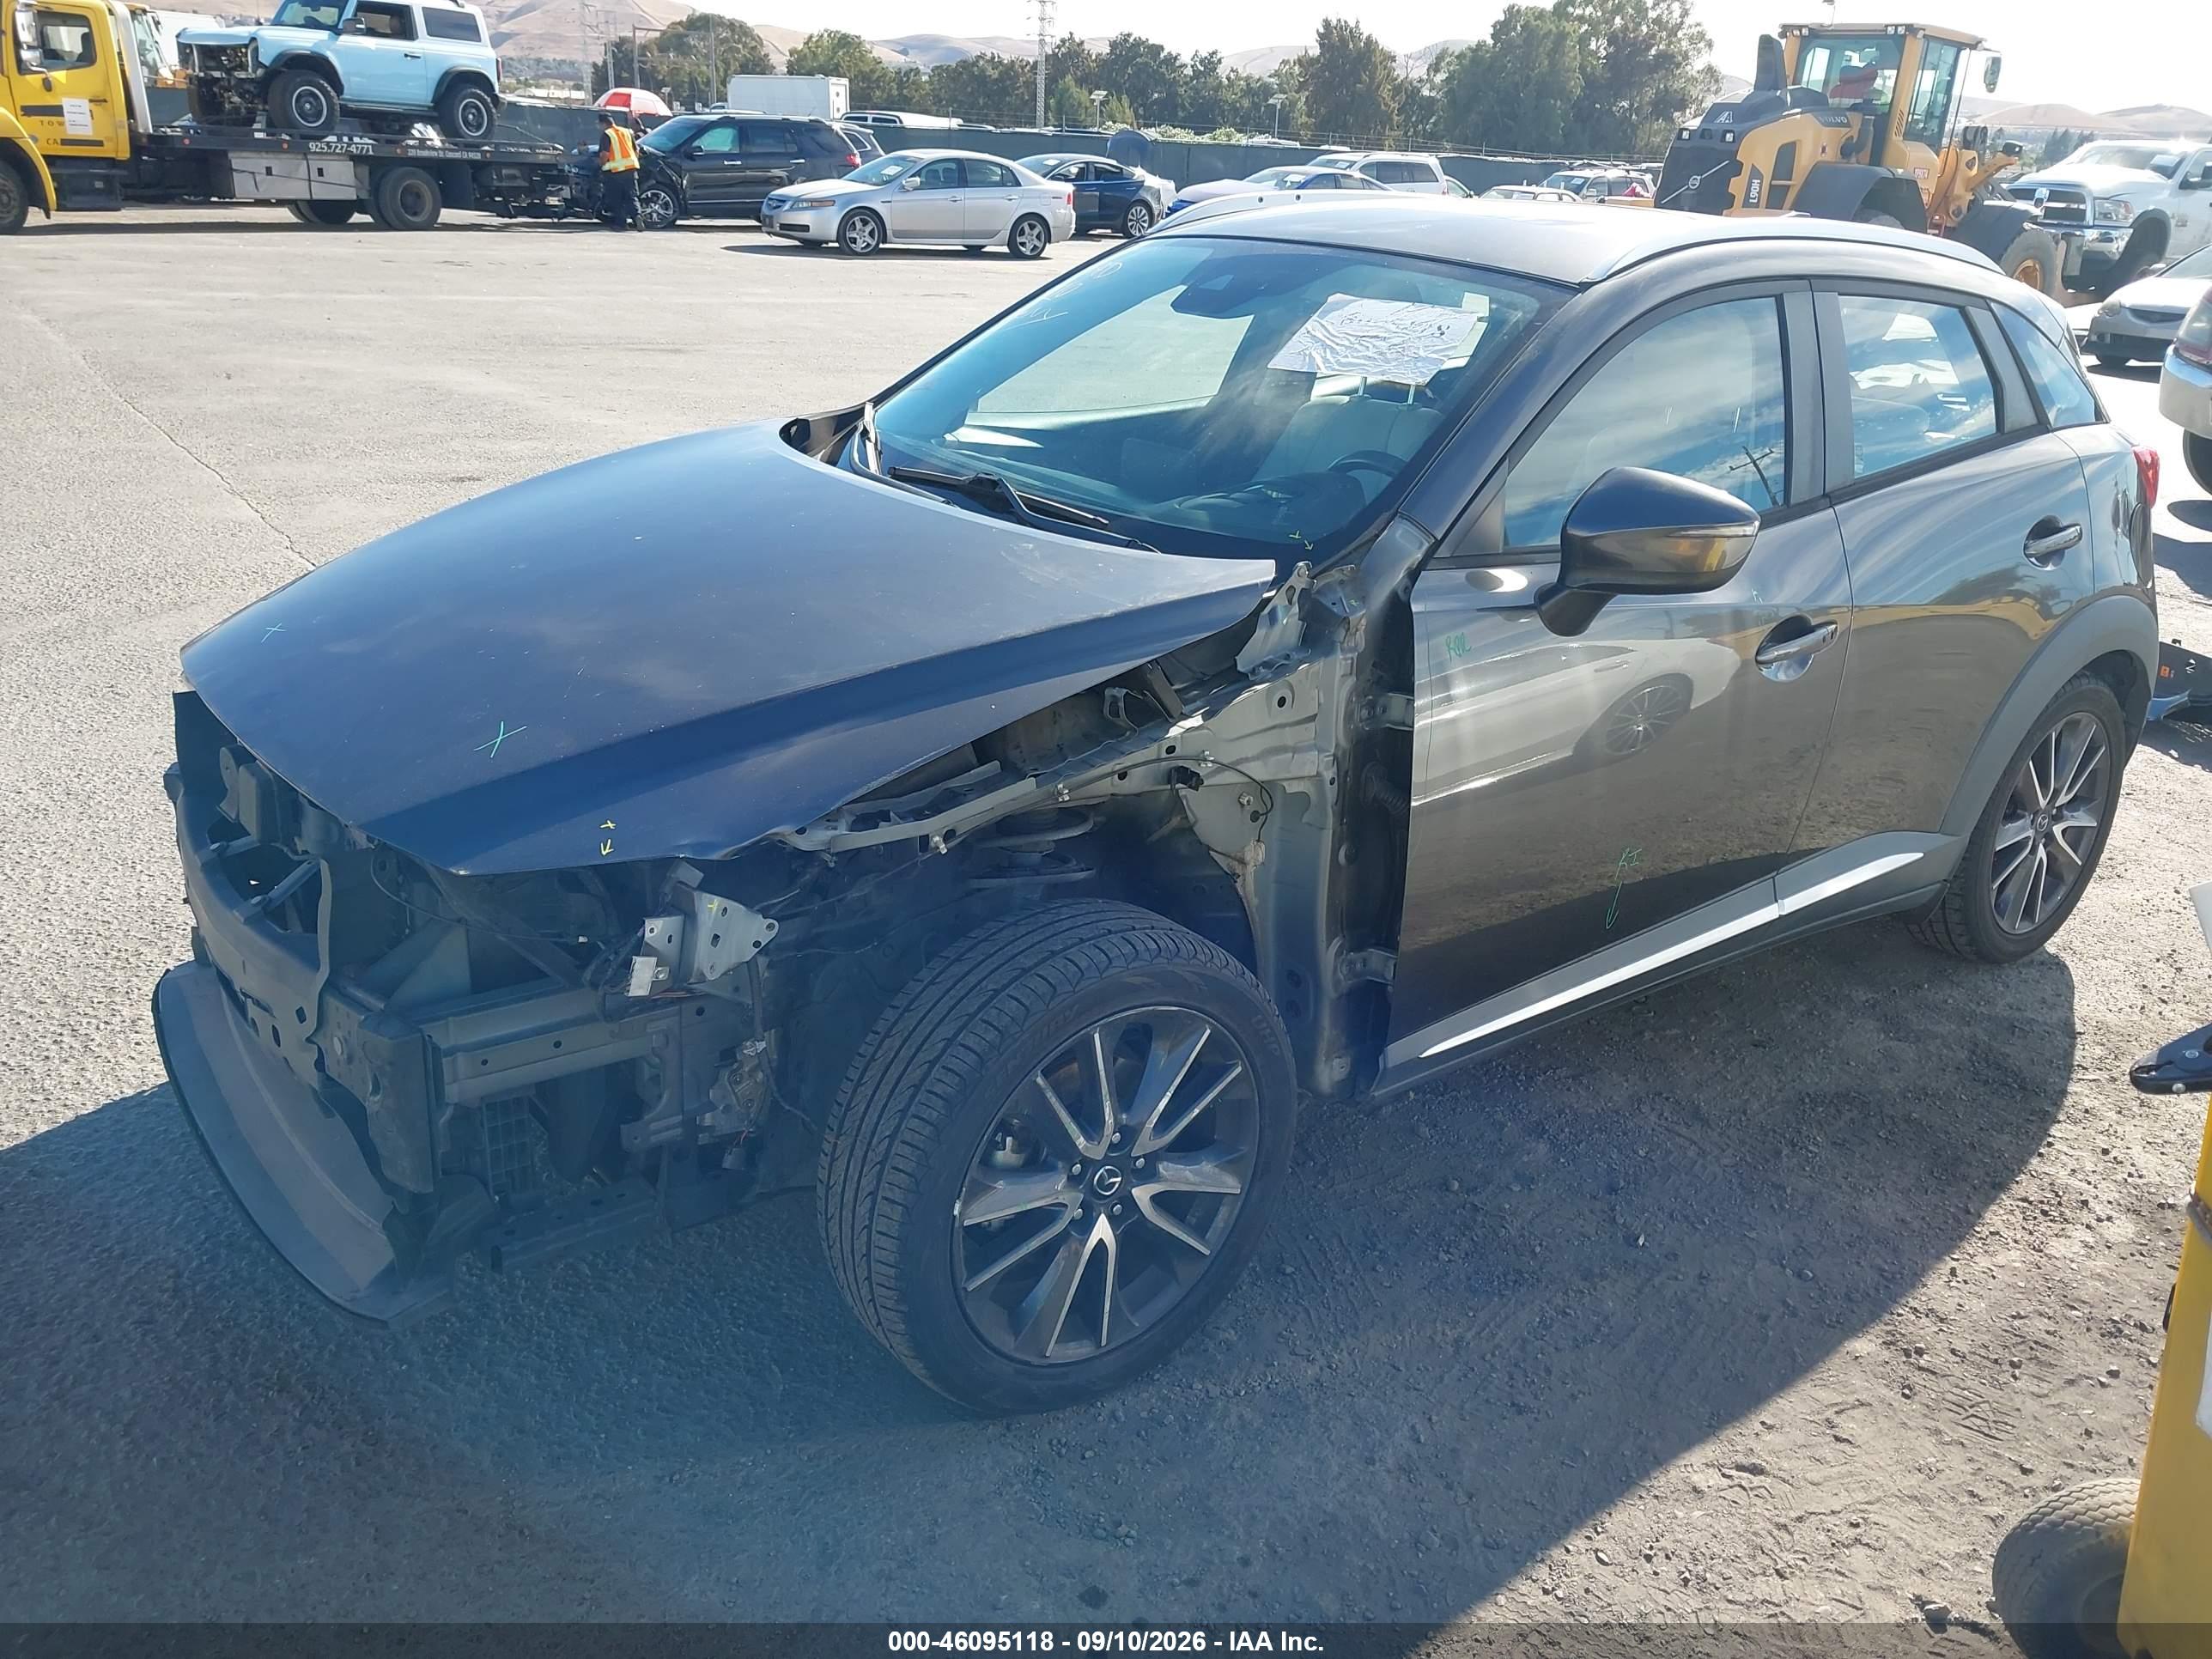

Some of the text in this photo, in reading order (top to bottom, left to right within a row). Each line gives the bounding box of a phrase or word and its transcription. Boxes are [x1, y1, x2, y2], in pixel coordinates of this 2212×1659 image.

[309, 142, 374, 155] 925.727-4771
[1748, 179, 1761, 203] L90H
[1250, 1014, 1281, 1059] UHP
